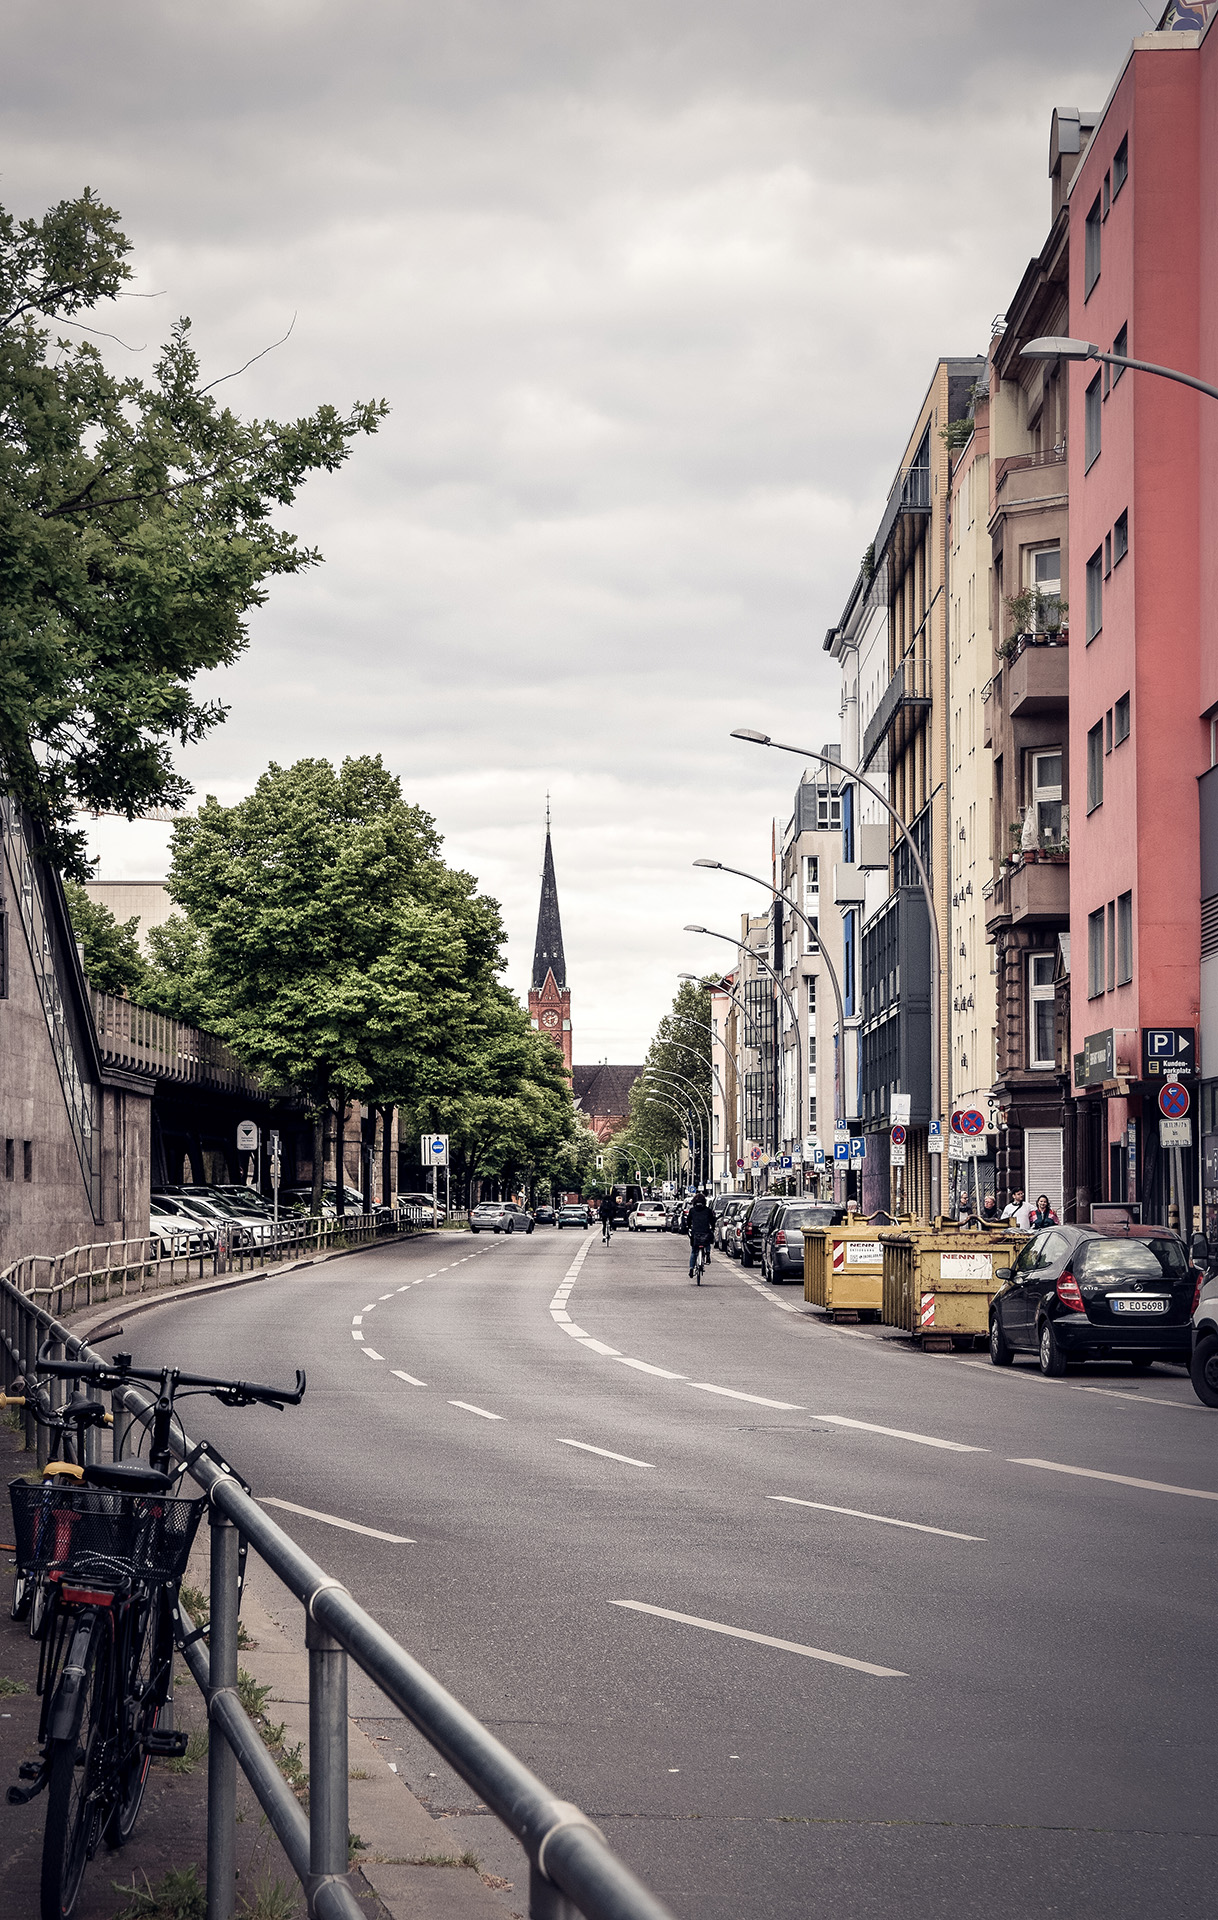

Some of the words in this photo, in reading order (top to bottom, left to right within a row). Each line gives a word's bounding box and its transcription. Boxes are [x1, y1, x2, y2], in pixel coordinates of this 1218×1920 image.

[1154, 1034, 1169, 1053] P
[1163, 1067, 1191, 1075] parkplatz
[837, 1145, 846, 1158] P
[852, 1139, 861, 1156] P
[816, 1150, 823, 1162] P
[783, 1158, 790, 1167] P
[1119, 1302, 1125, 1310] B
